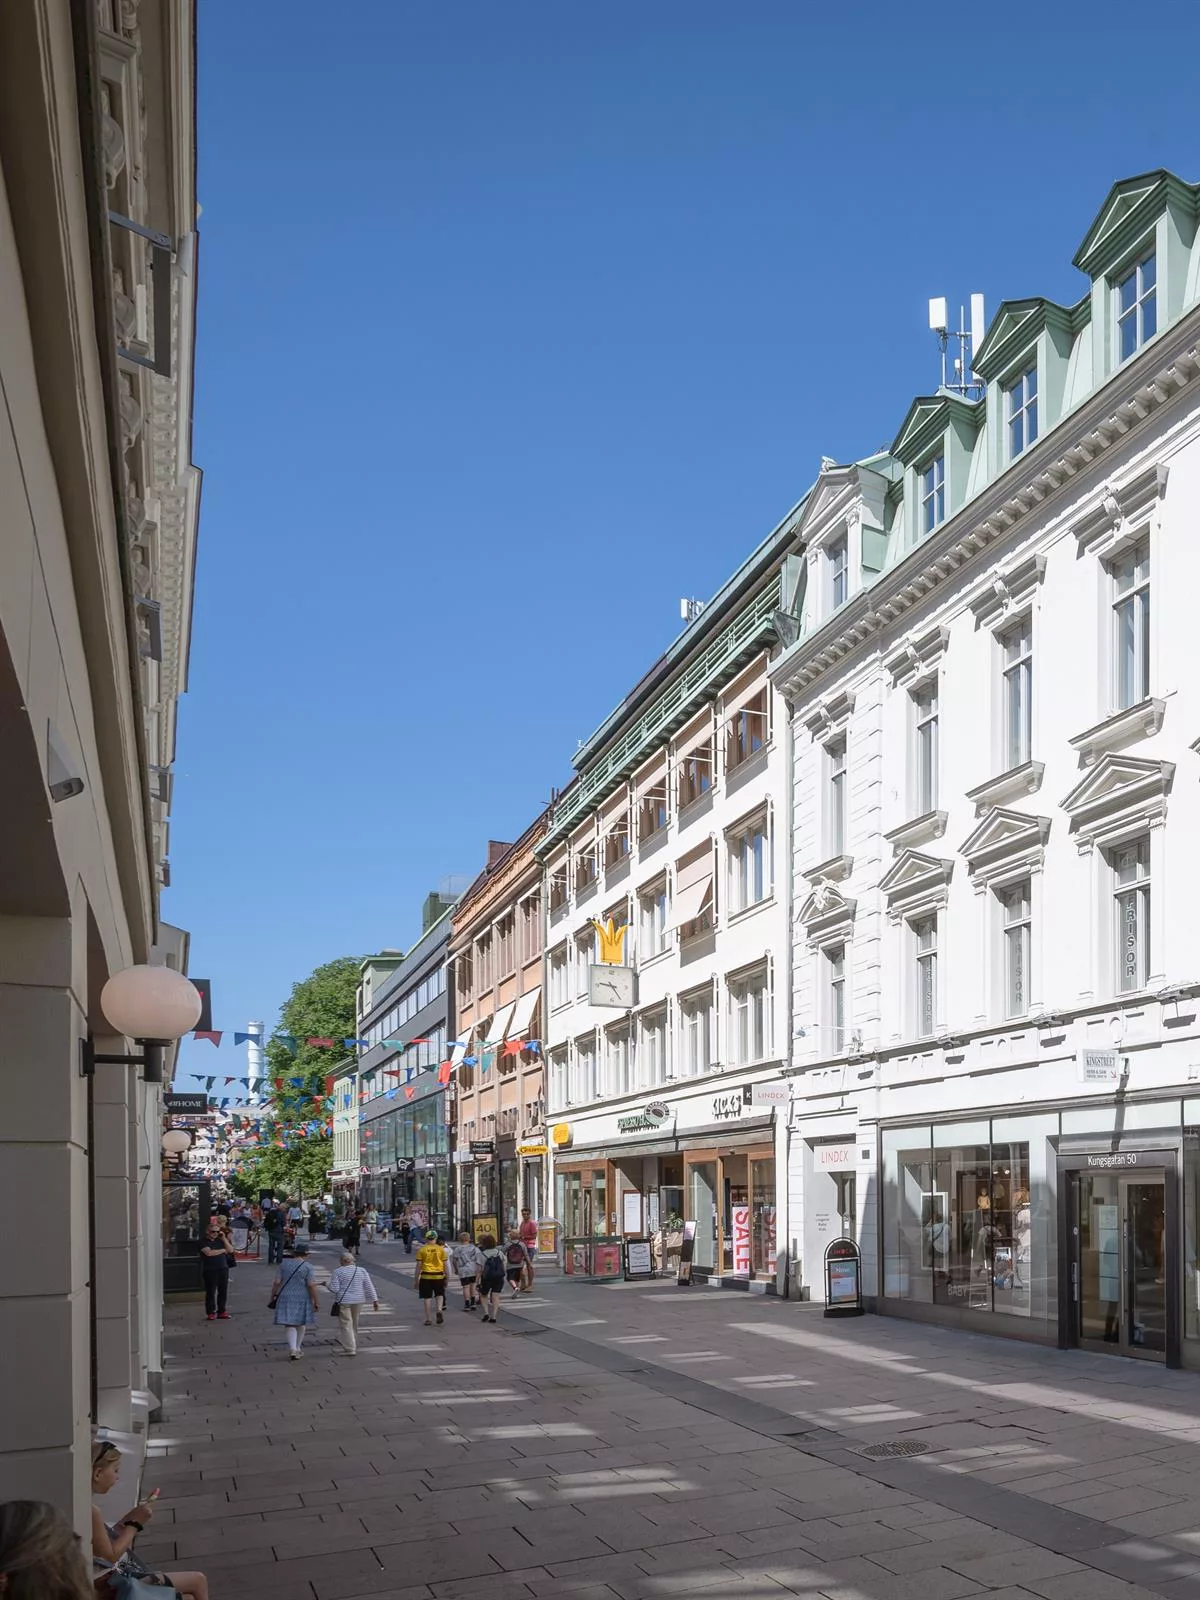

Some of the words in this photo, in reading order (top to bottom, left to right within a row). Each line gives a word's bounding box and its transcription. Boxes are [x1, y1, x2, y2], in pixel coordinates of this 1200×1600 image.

[821, 1150, 849, 1164] LINDEX
[1088, 1155, 1125, 1168] Kungsgatan
[1127, 1153, 1137, 1164] 50
[735, 1211, 752, 1271] SALE
